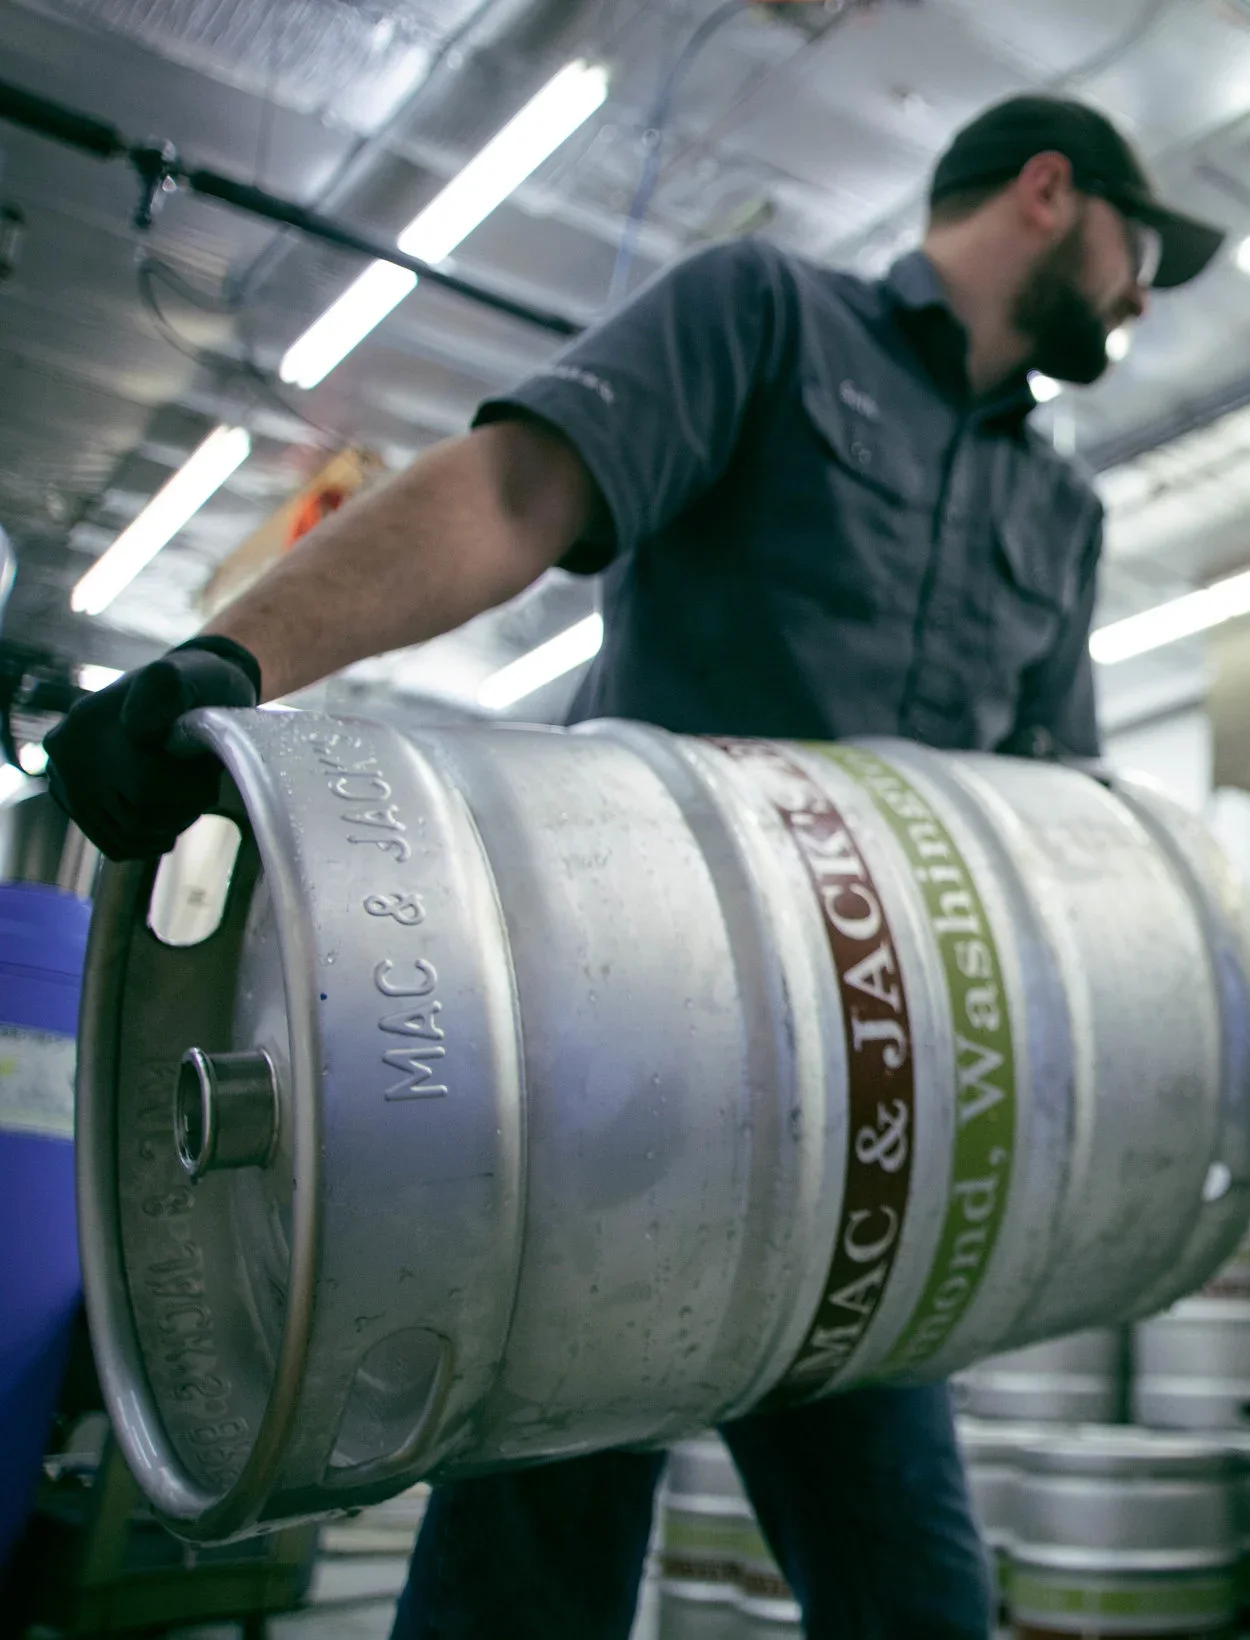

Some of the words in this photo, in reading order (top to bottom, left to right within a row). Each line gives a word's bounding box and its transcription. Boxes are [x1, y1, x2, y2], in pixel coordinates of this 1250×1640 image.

[363, 891, 427, 926] &
[371, 958, 448, 1102] MAC
[786, 1205, 898, 1378] MAC
[855, 1099, 908, 1173] &
